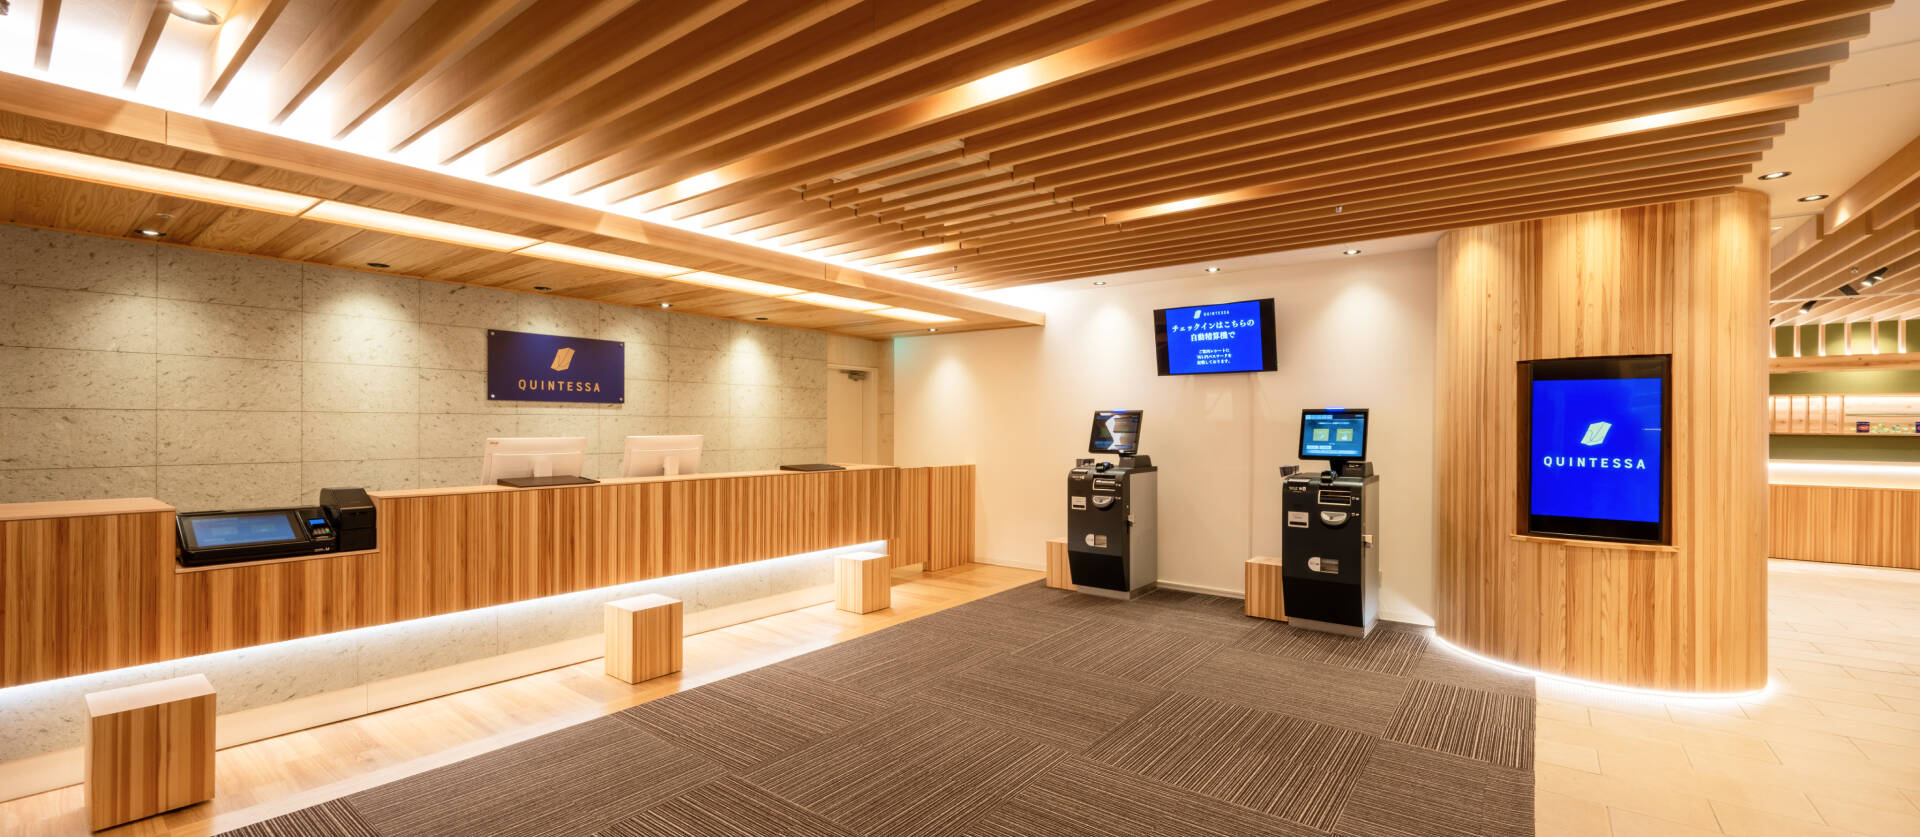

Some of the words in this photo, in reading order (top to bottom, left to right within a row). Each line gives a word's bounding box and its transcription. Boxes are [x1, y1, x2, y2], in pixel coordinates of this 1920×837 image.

[1172, 319, 1255, 333] チェックインはこちらの
[1190, 331, 1236, 342] 自動精算機で
[518, 379, 601, 393] QUINTESSA
[1543, 456, 1646, 470] QUINTESSA
